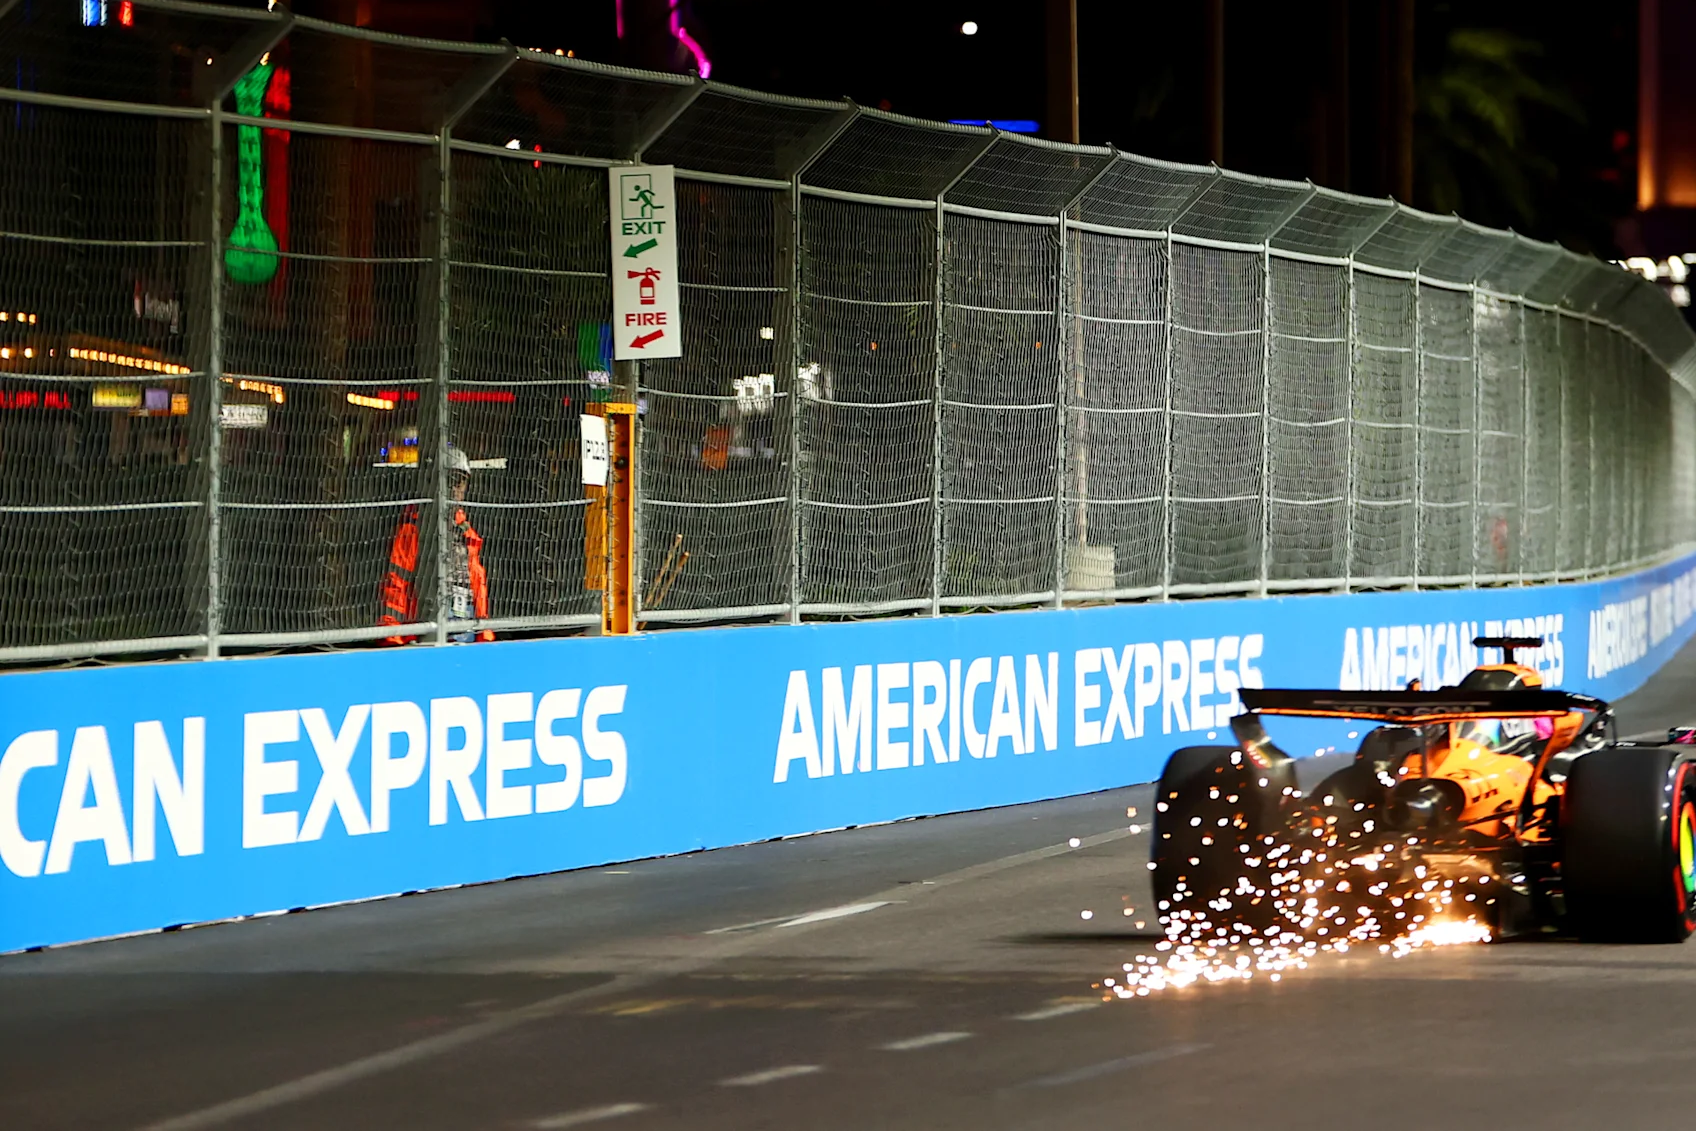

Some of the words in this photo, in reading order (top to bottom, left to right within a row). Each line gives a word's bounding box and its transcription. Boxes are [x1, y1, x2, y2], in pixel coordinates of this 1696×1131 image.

[621, 220, 667, 236] EXIT
[625, 312, 668, 327] FIRE
[1340, 621, 1478, 691] AMERICAN
[773, 652, 1059, 783] AMERICAN
[1075, 634, 1264, 747] EXPRESS
[0, 717, 205, 877] CAN
[242, 684, 627, 849] EXPRESS
